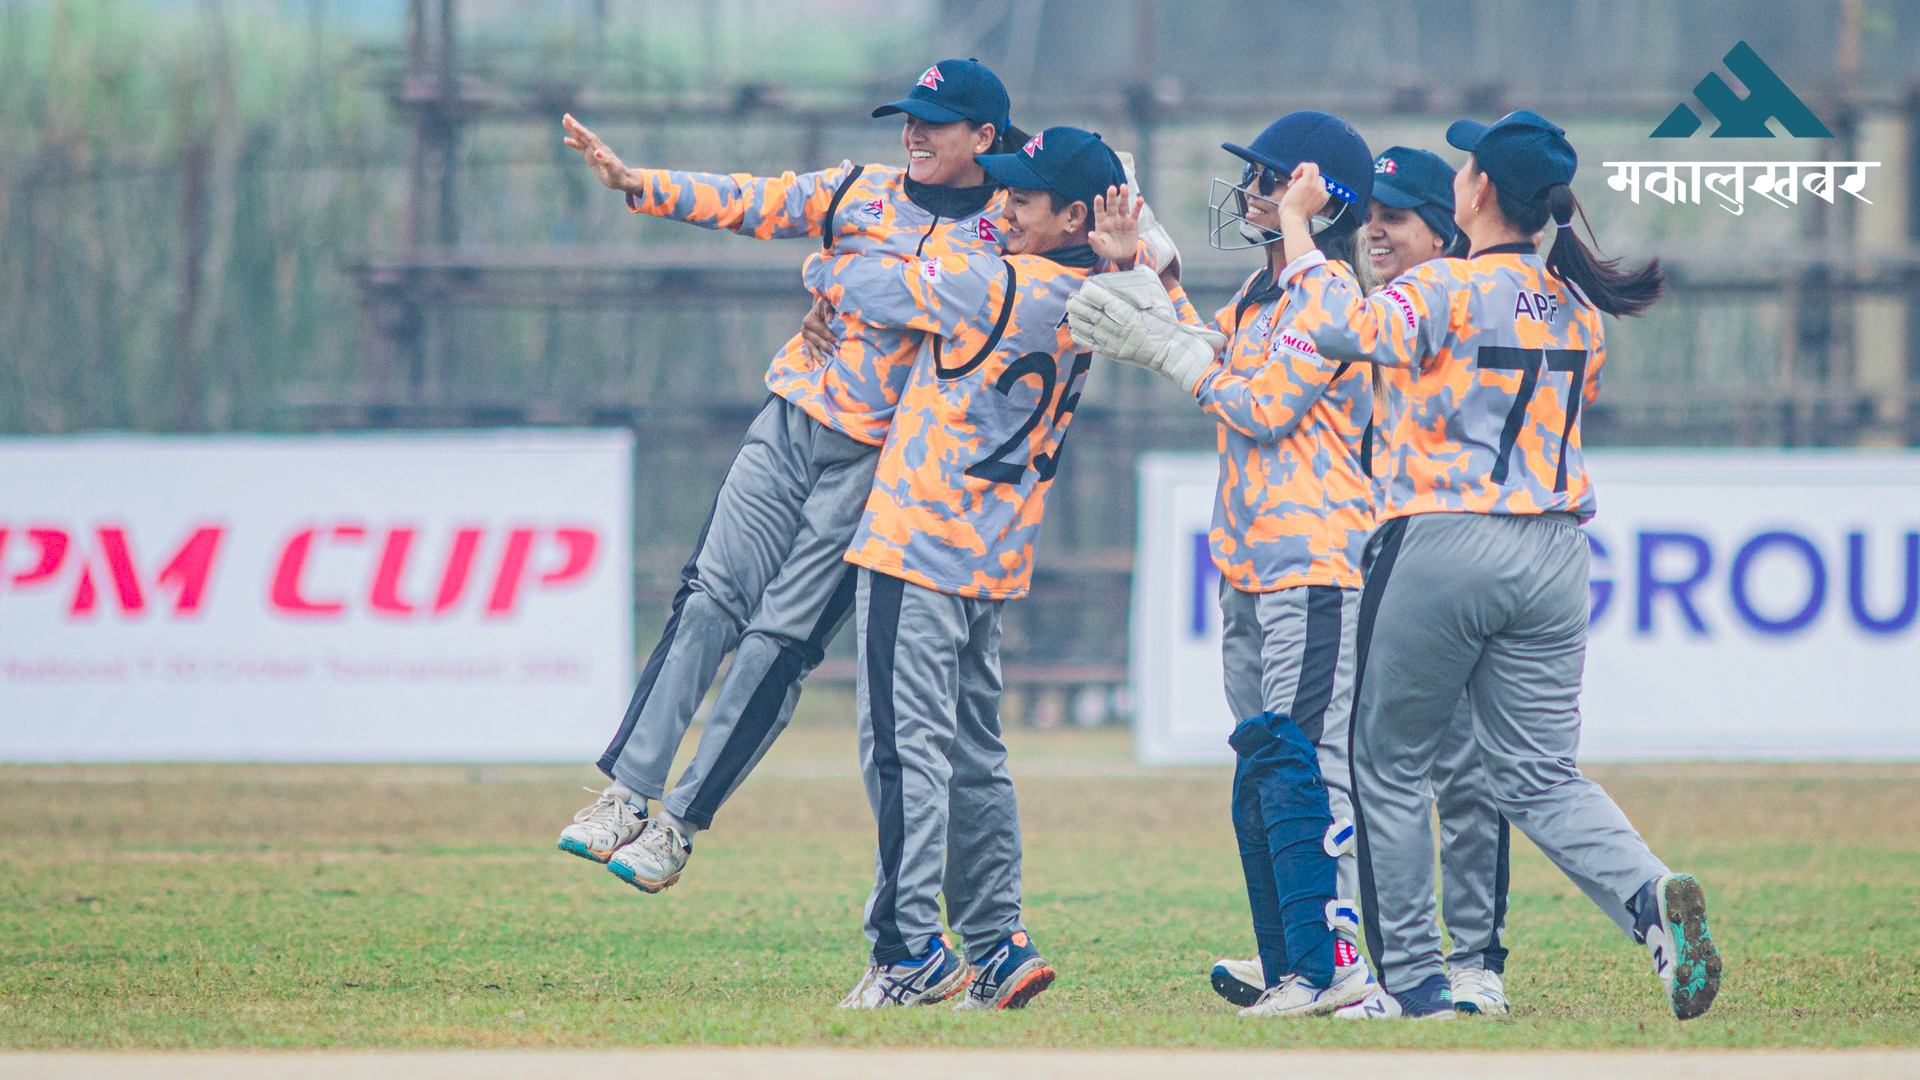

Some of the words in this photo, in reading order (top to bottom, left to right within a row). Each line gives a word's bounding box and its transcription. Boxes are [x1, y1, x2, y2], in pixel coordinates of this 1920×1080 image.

[1402, 304, 1416, 329] CUP
[1514, 291, 1558, 323] APF
[964, 351, 1094, 486] 25
[1477, 346, 1588, 494] 77
[268, 524, 600, 616] CUP
[1590, 530, 1920, 635] ROU
